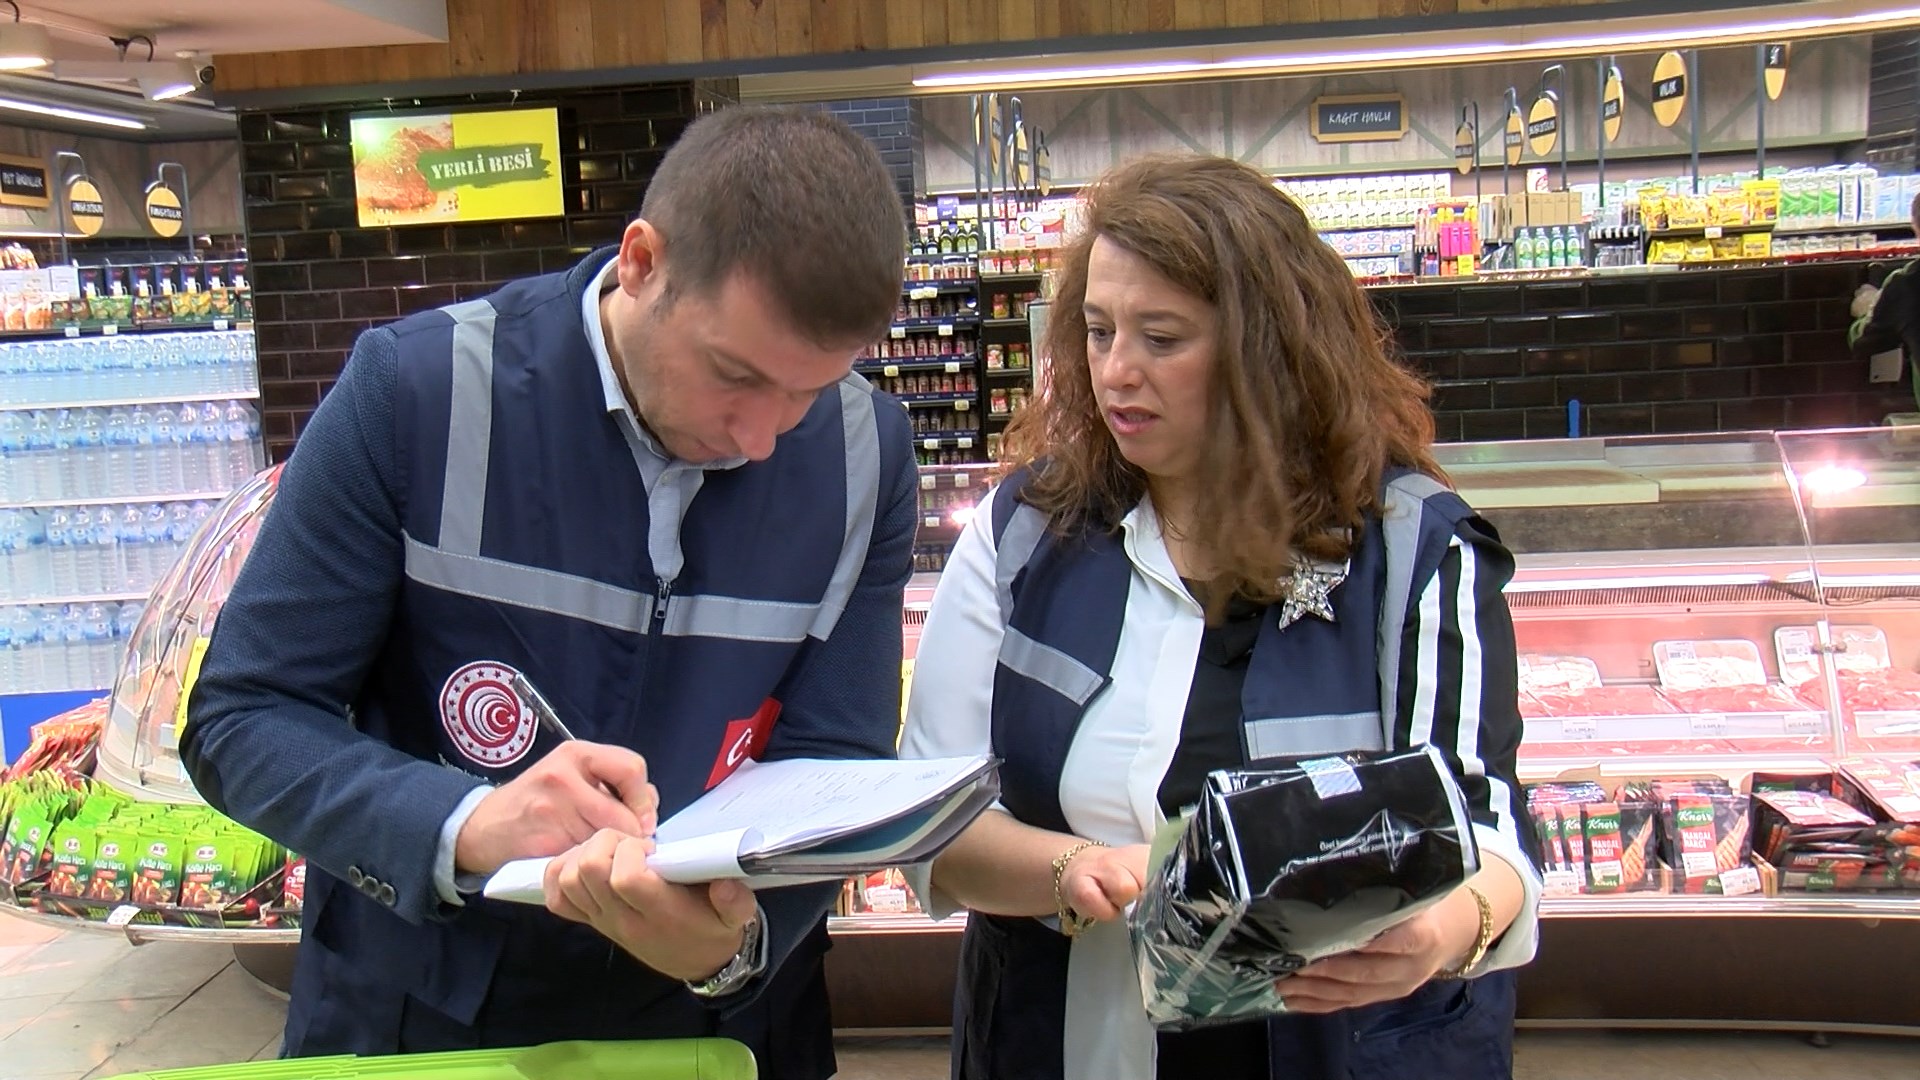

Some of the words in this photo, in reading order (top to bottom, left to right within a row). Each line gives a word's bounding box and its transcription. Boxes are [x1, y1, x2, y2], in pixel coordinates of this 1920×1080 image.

[431, 154, 485, 179] YERLİ
[489, 148, 533, 173] BESİ
[1678, 809, 1713, 822] Knorr
[1586, 818, 1620, 830] Knorr
